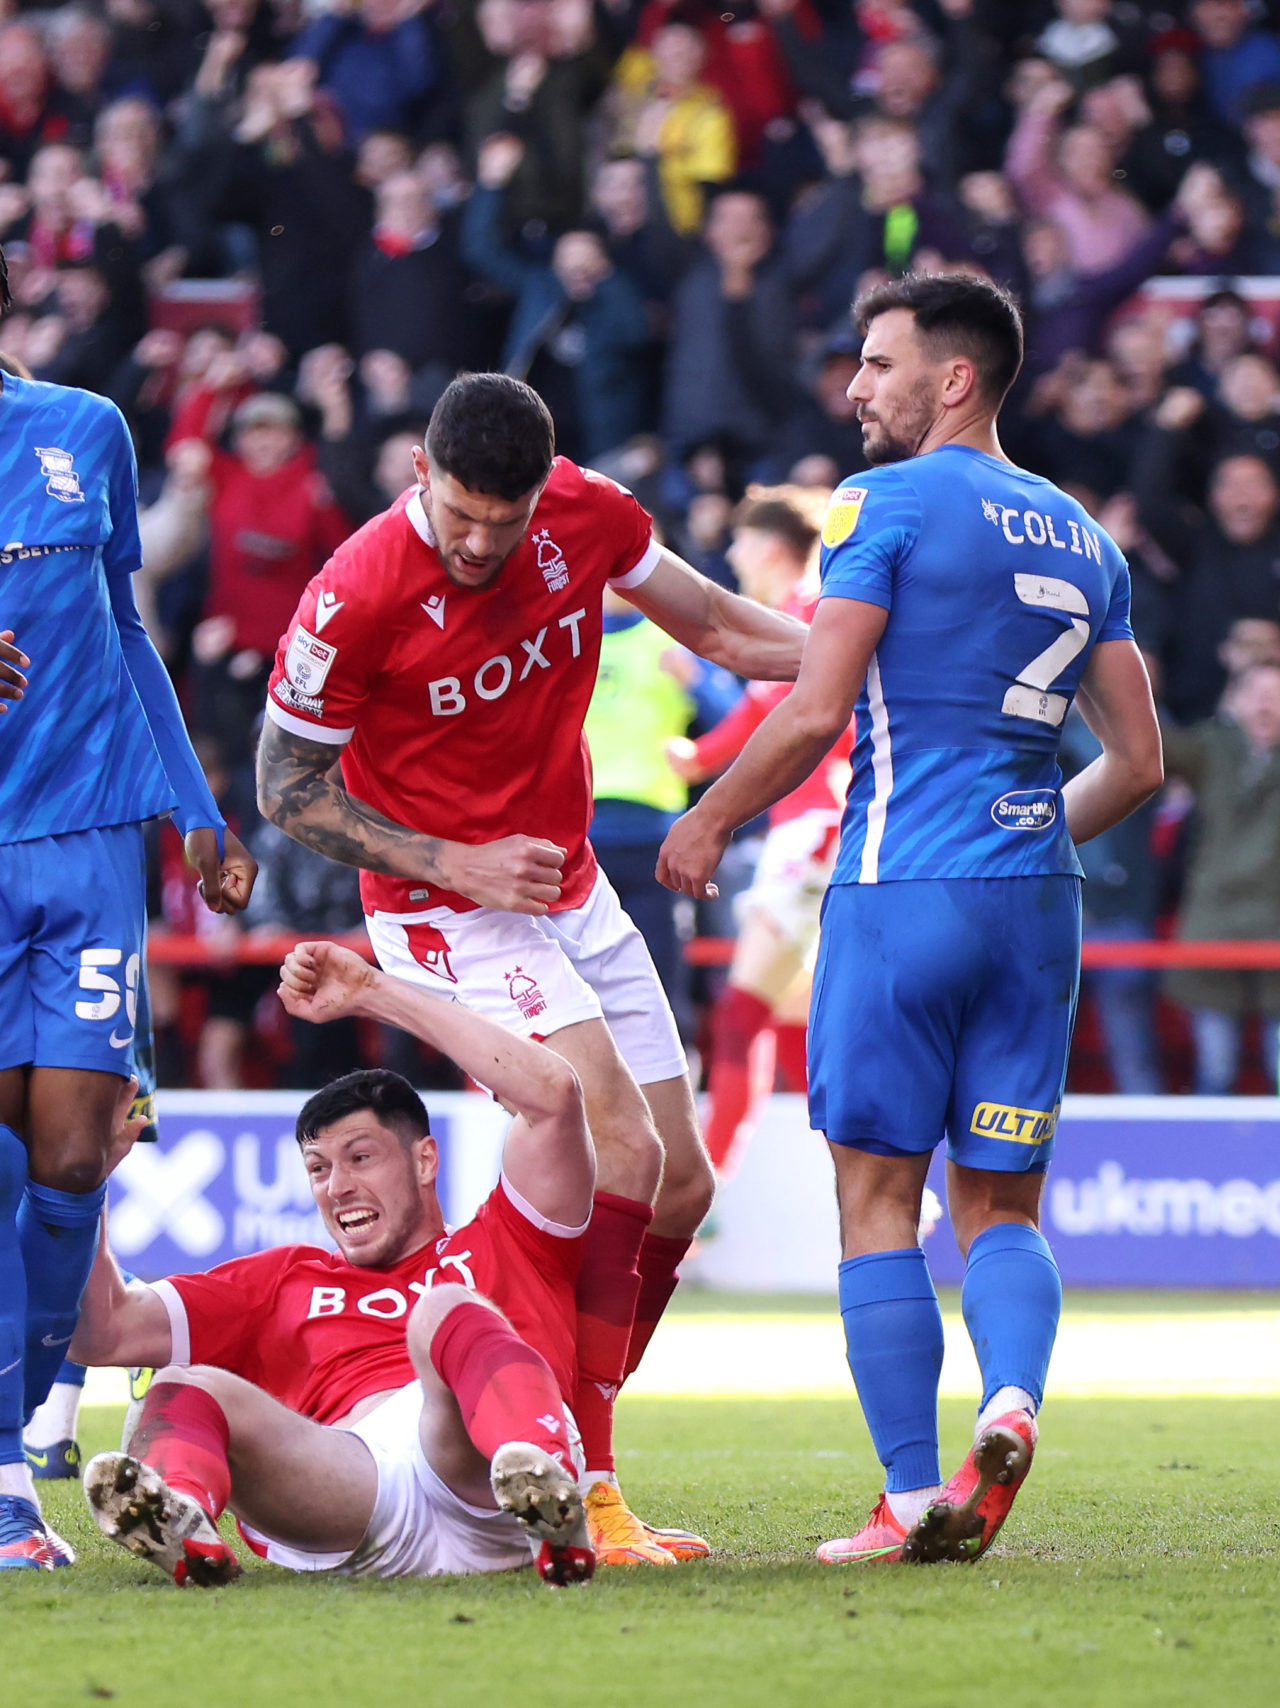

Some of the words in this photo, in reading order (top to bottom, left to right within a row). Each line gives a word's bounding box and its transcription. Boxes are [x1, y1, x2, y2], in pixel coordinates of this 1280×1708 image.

[1001, 508, 1101, 566] COLIN
[428, 607, 586, 716] BOXT
[1000, 572, 1091, 728] 2
